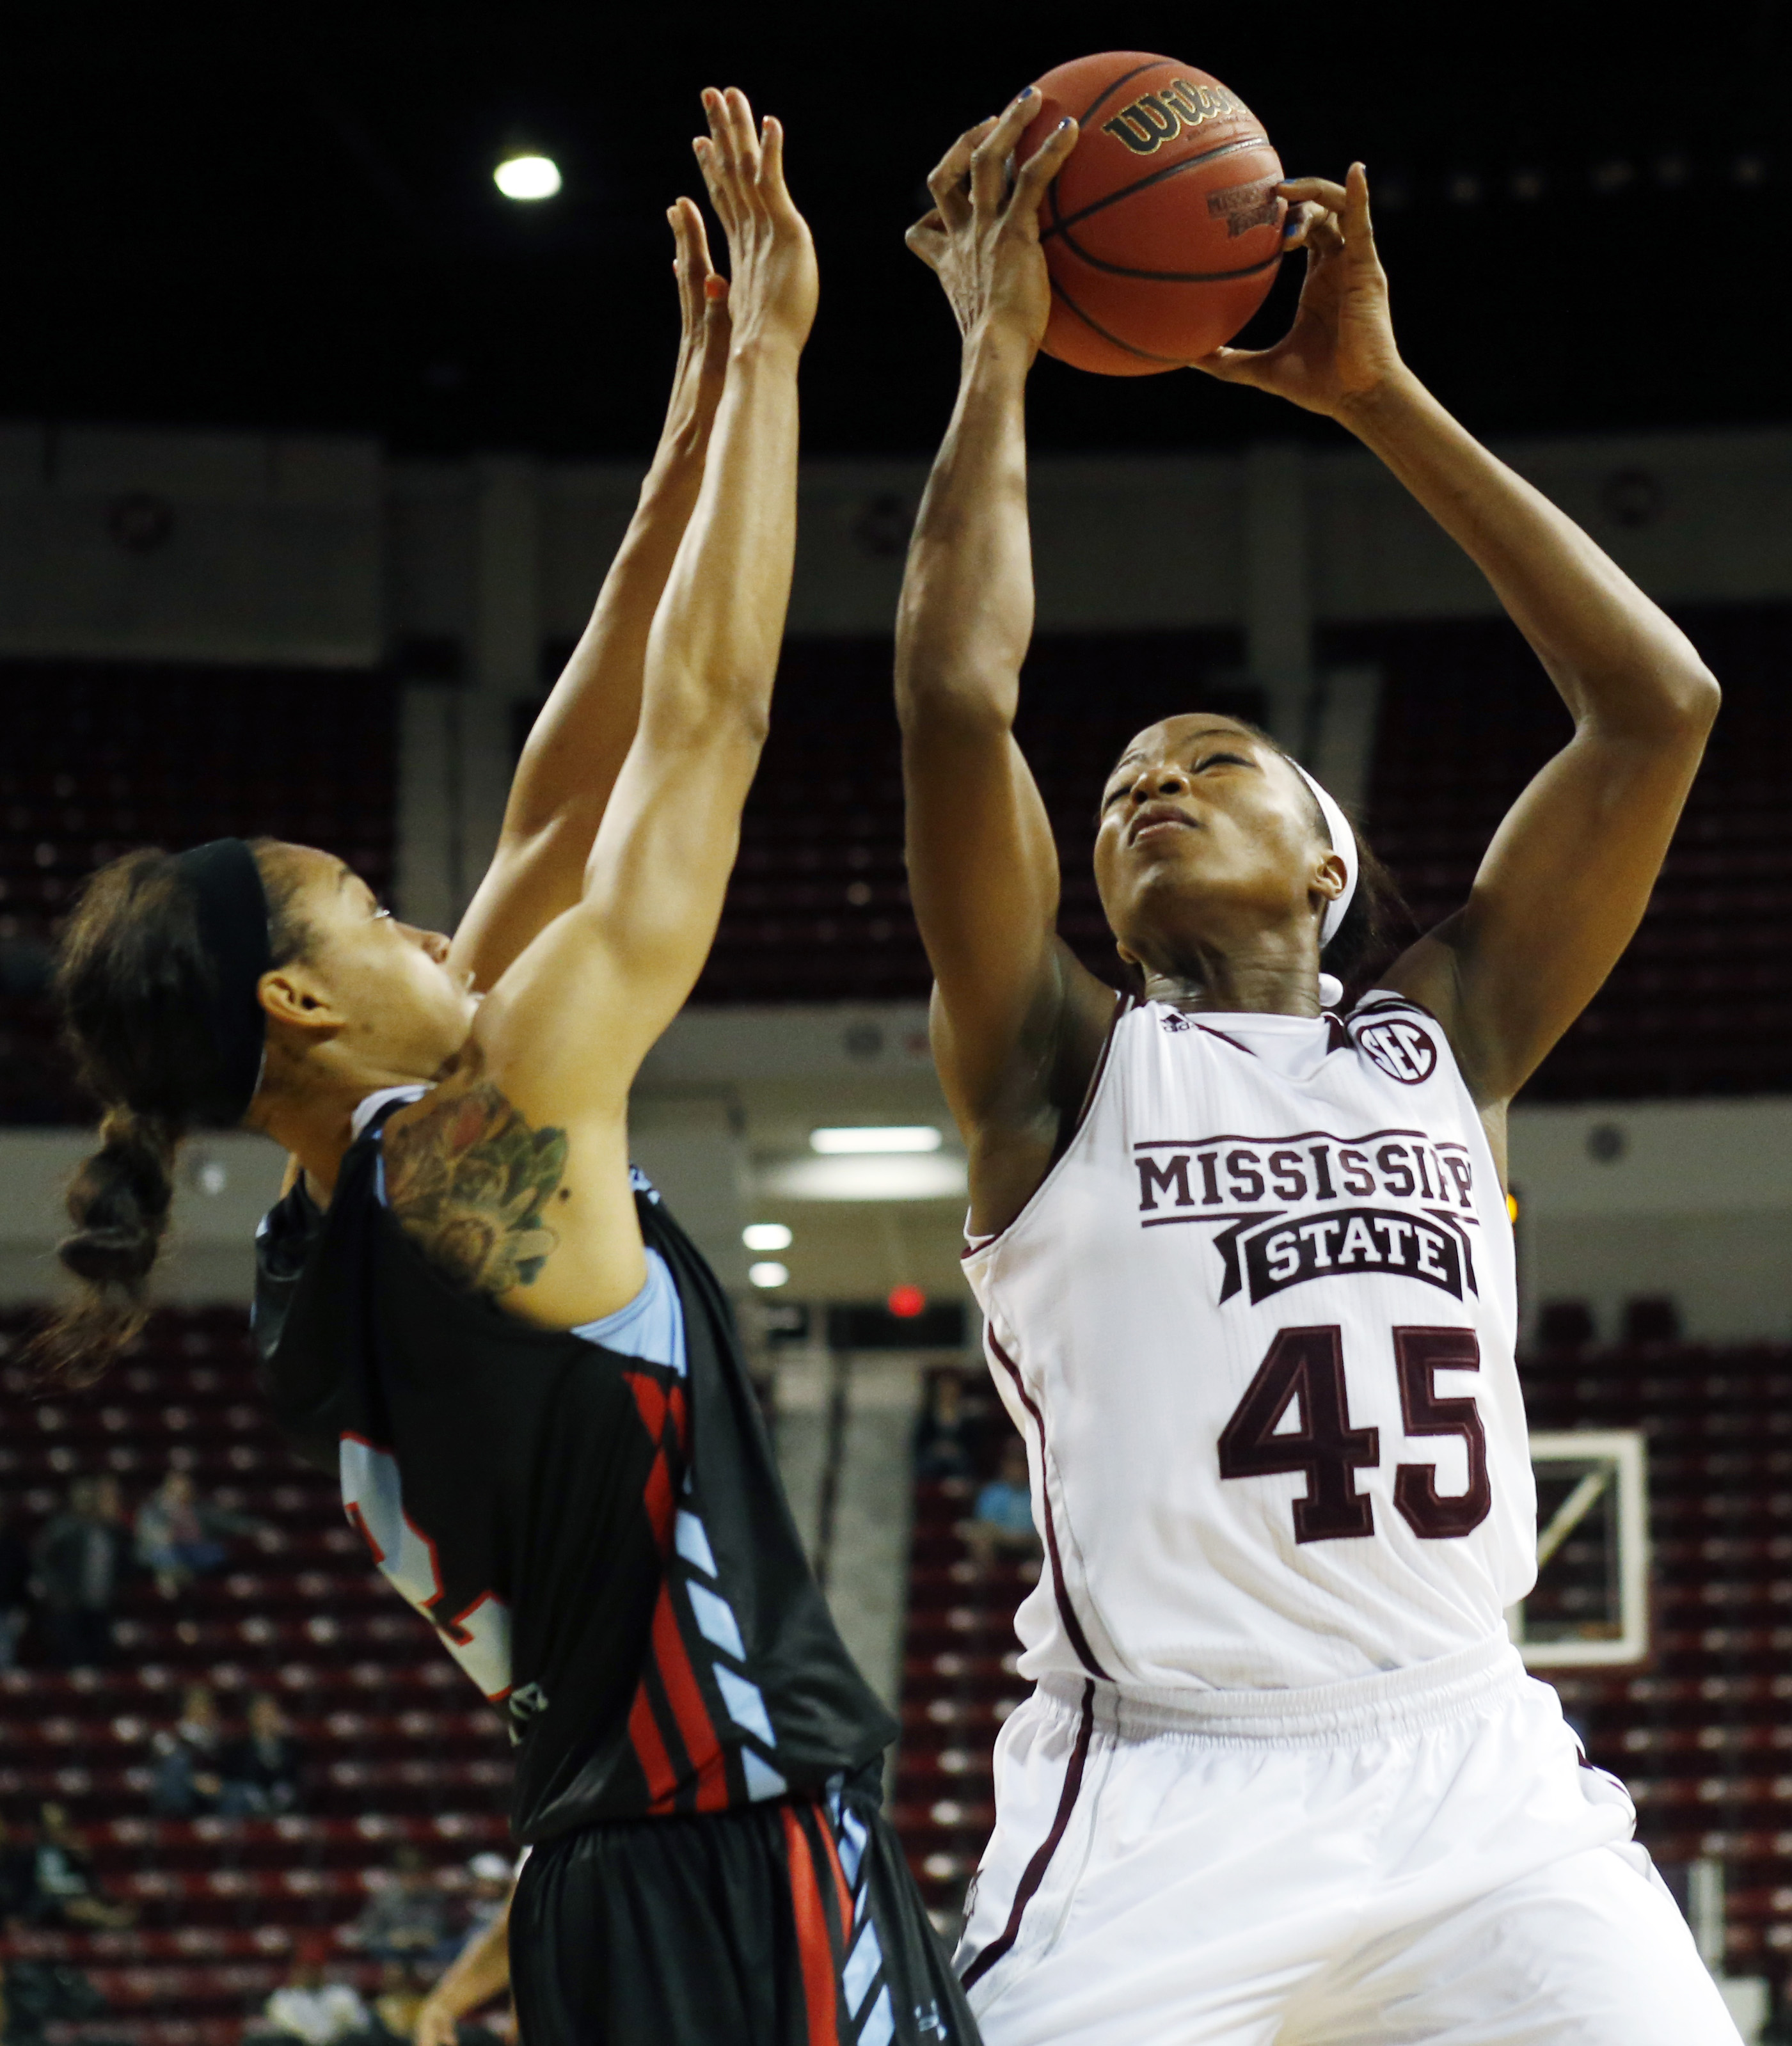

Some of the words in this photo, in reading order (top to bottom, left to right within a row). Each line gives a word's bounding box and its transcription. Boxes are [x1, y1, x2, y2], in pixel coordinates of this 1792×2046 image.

[1361, 1024, 1432, 1081] SEC
[1265, 1217, 1448, 1281] STATE
[1218, 1325, 1491, 1544] 45
